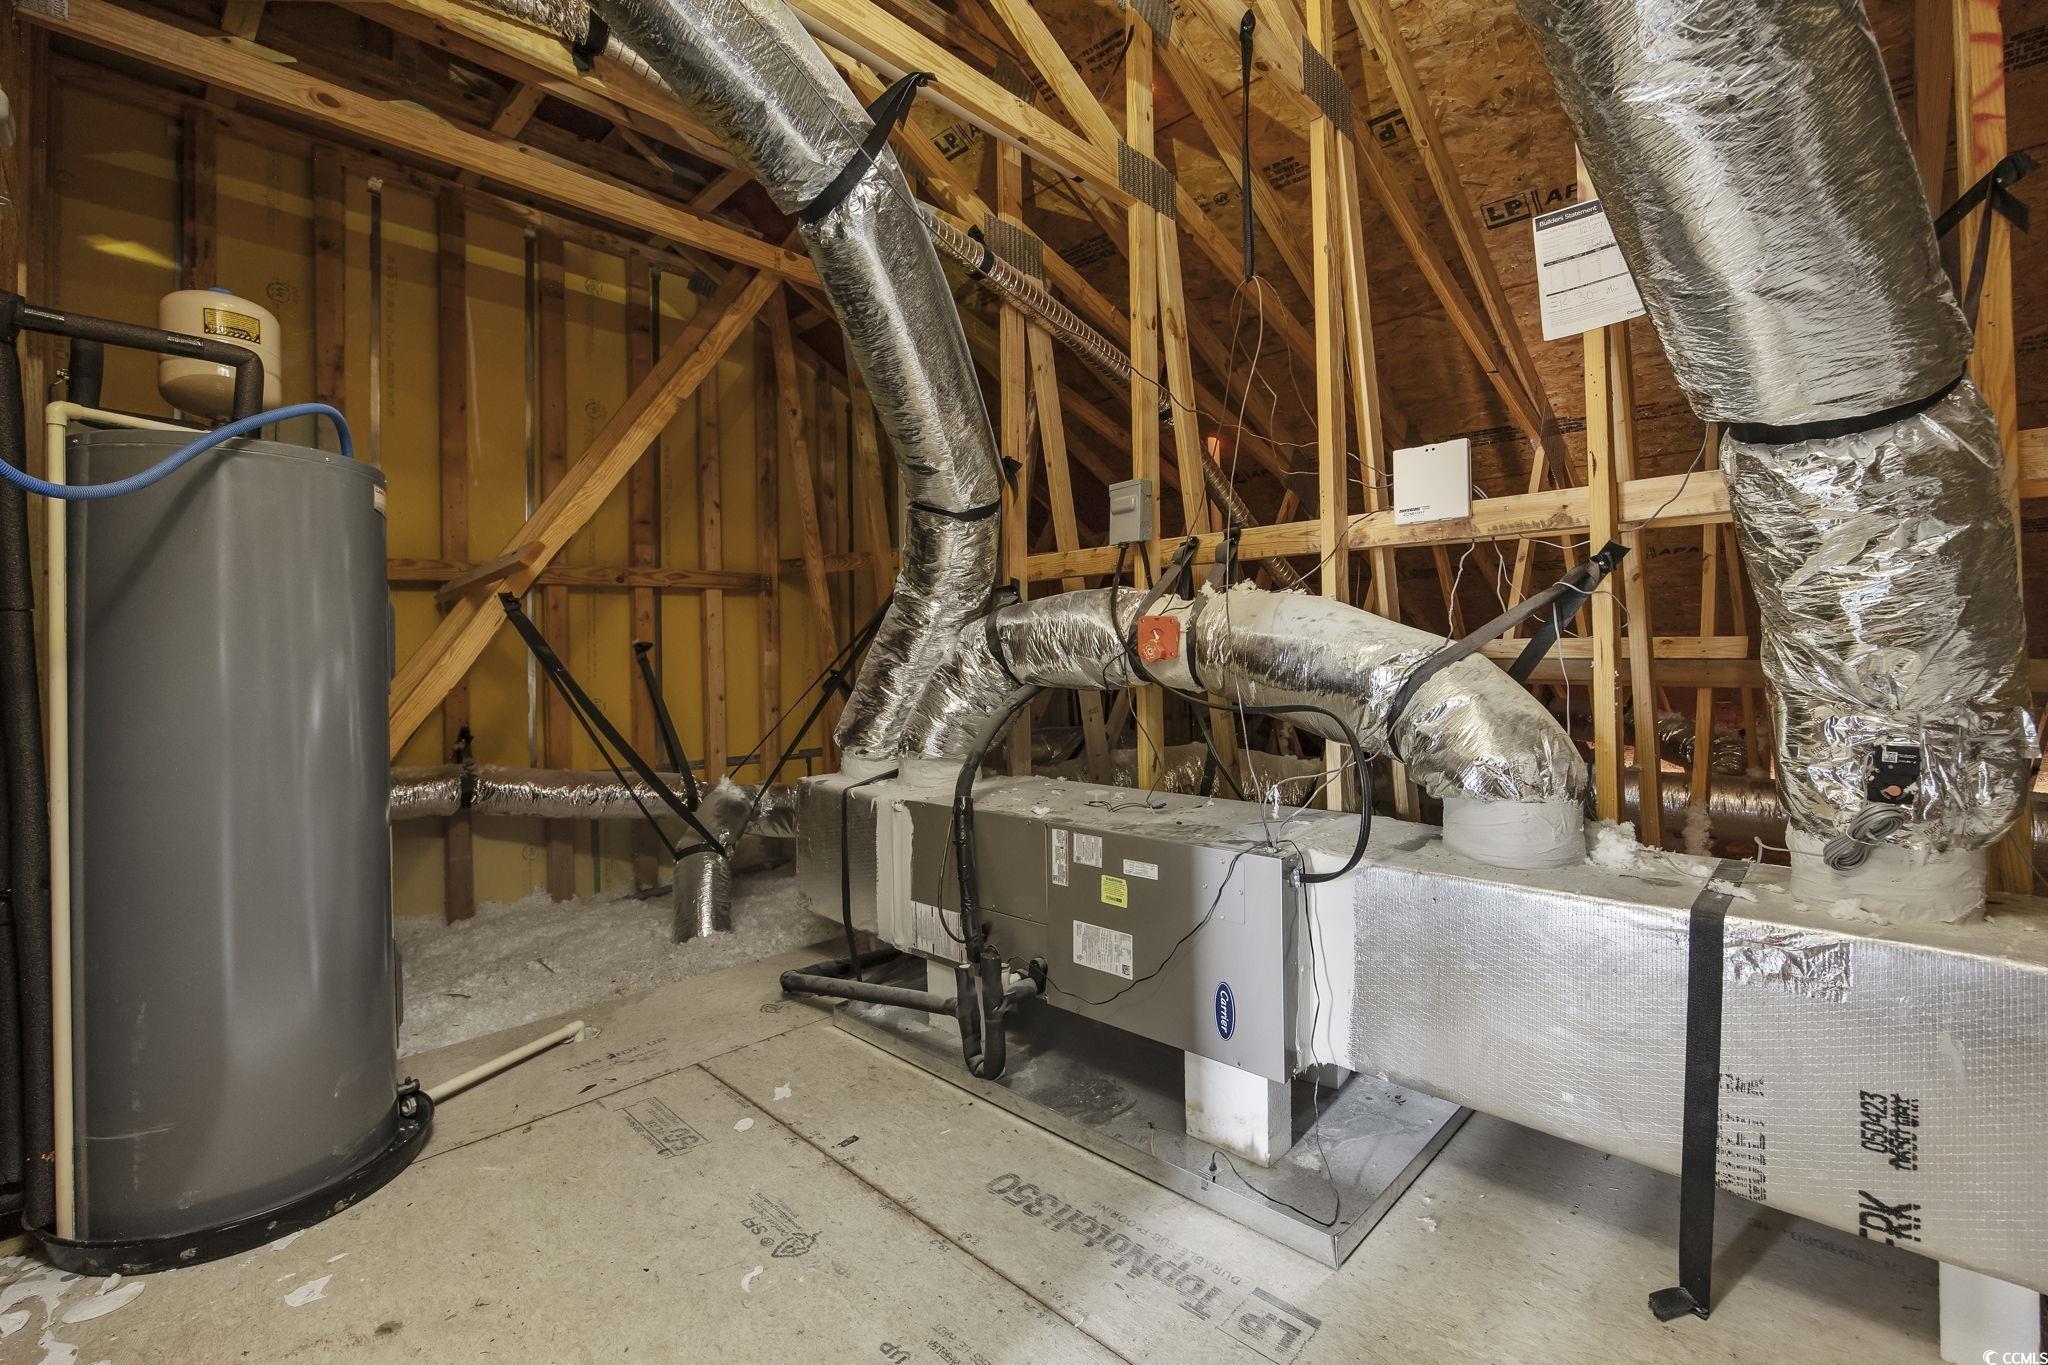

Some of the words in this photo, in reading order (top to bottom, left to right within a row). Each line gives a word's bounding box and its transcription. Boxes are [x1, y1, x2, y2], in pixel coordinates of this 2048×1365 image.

[933, 132, 959, 155] LP
[1486, 199, 1523, 223] LP
[1539, 216, 1564, 228] Builders
[1565, 204, 1597, 219] Statement
[1220, 990, 1229, 1033] Carrier
[1859, 1089, 1888, 1154] 050423
[1238, 1311, 1302, 1355] LP
